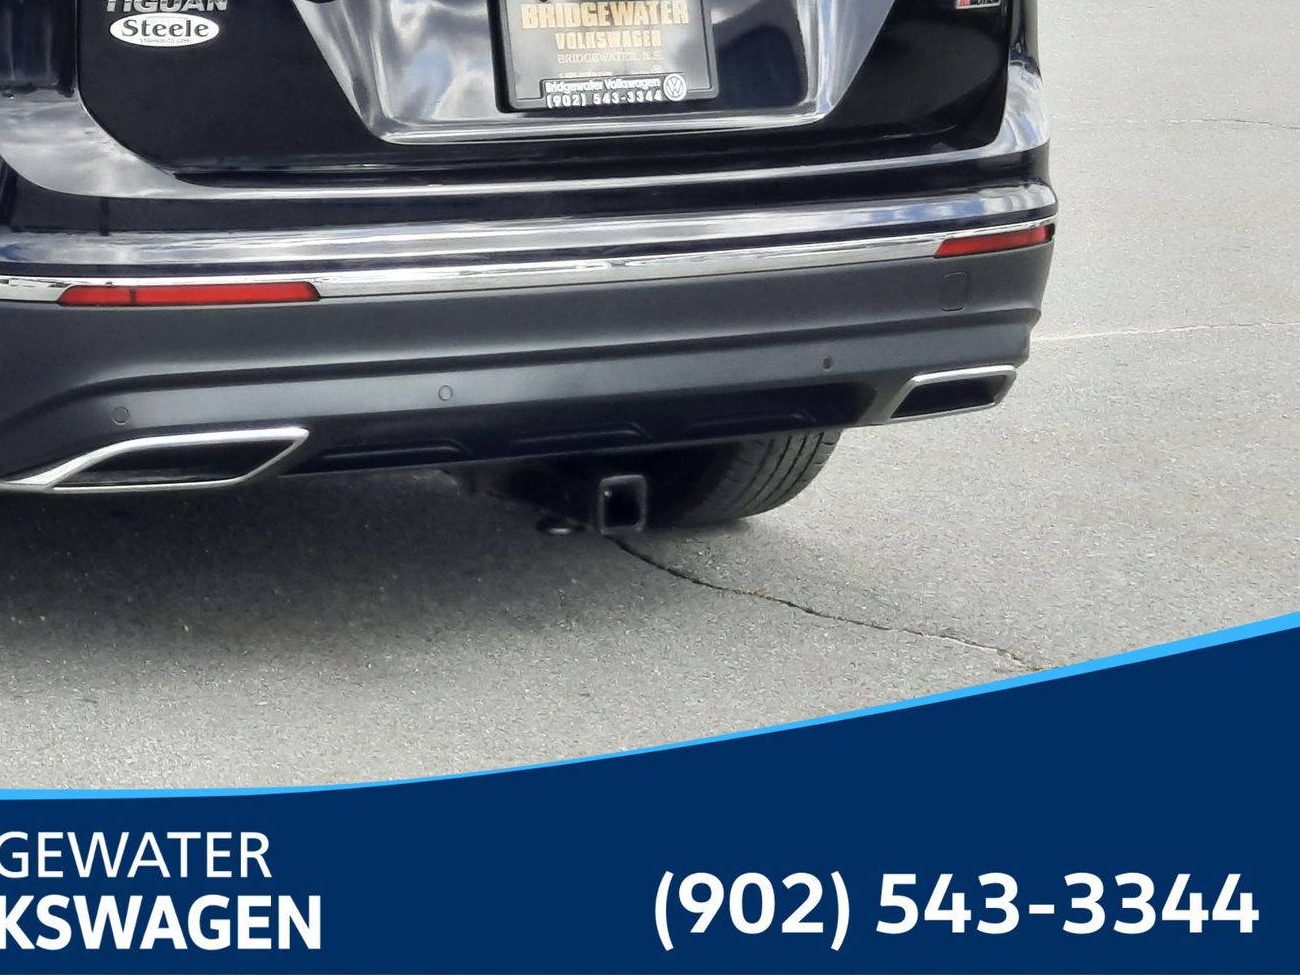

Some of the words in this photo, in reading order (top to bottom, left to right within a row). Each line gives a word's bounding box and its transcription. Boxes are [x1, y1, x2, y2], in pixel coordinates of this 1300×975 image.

[521, 0, 690, 29] BRIDGEWATER
[122, 19, 209, 37] Steele
[554, 29, 662, 50] VOLKSWAGEN
[604, 77, 660, 90] Volkswagen
[546, 92, 586, 108] (902)
[593, 88, 662, 105] 543-3344
